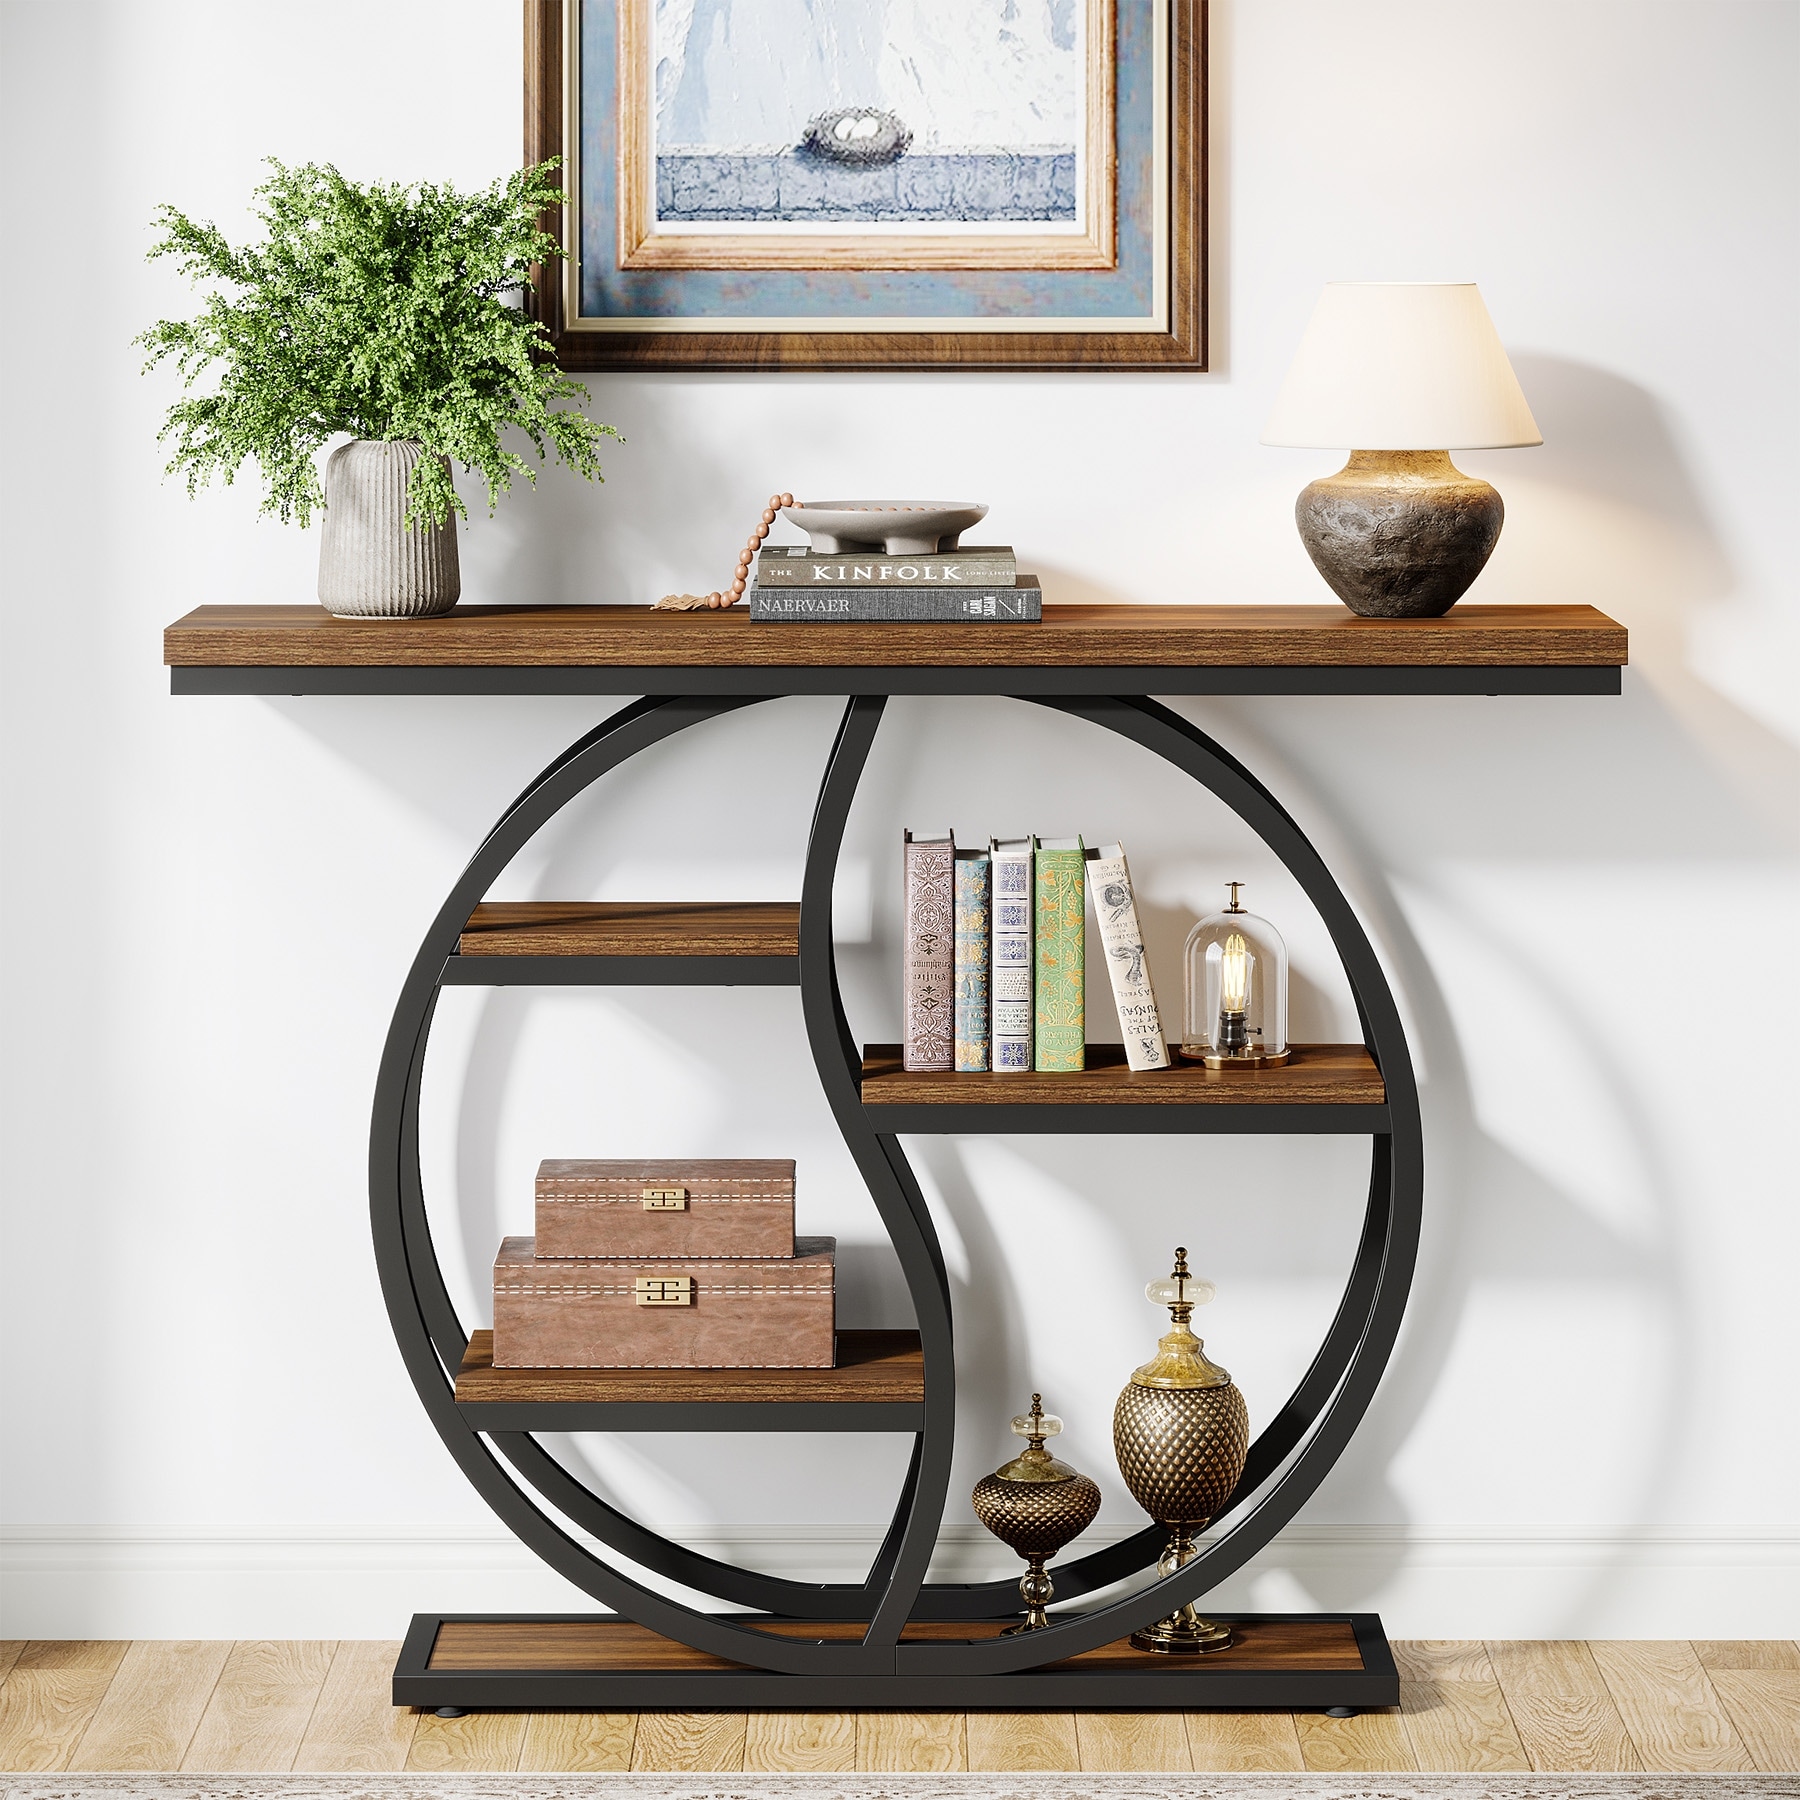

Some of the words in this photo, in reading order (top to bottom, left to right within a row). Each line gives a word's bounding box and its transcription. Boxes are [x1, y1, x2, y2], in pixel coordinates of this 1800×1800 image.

[813, 565, 962, 580] KINFOLK
[758, 599, 850, 612] NAERVAER
[969, 598, 983, 614] CARL
[983, 596, 996, 617] SAGAN
[1064, 1031, 1081, 1039] THE
[1127, 1023, 1163, 1036] TALES
[1056, 1039, 1081, 1047] LADY
